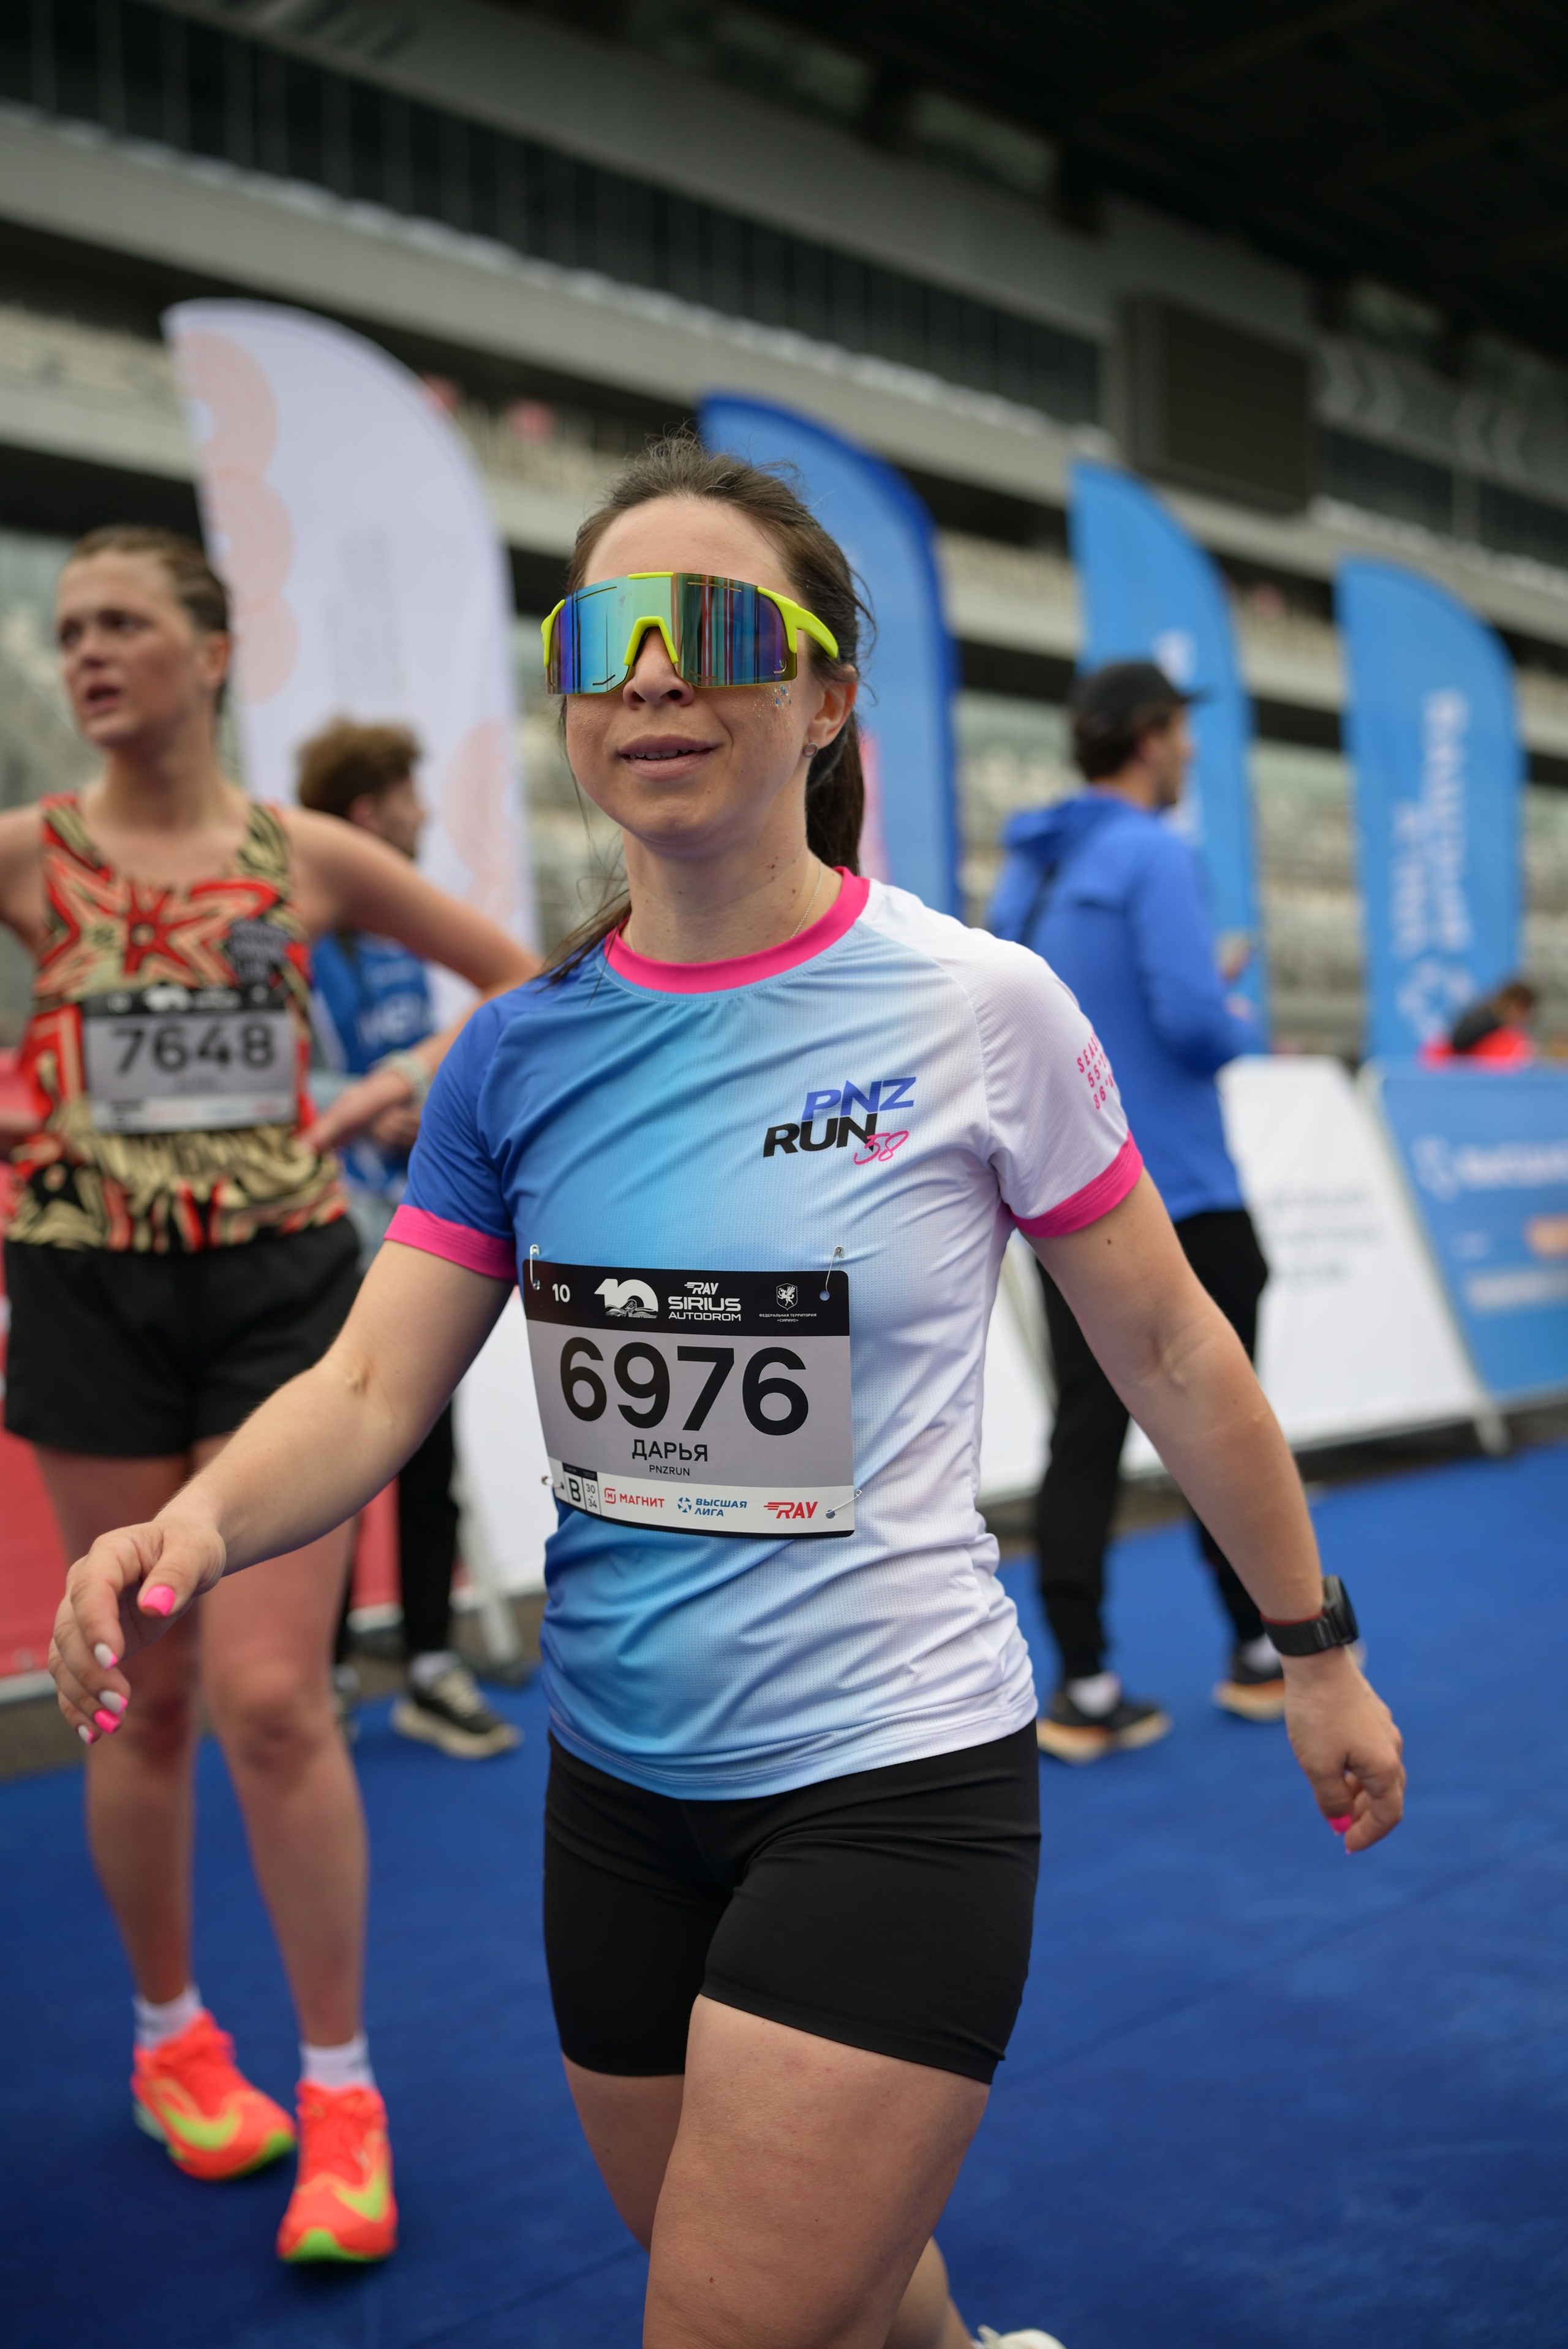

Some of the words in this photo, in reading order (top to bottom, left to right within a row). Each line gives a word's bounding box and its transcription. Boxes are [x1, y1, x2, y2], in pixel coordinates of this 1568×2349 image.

[112, 1024, 275, 1075] 7648
[1077, 1032, 1099, 1073] SEAS
[802, 1076, 916, 1121] PNZ
[763, 1113, 878, 1157] RUN
[854, 1130, 910, 1165] 58
[552, 1284, 570, 1303] 10
[684, 1281, 719, 1295] RAY
[668, 1296, 742, 1312] SIRIUS
[668, 1311, 742, 1322] AUTODROM
[560, 1336, 809, 1436] 6976
[631, 1439, 708, 1462] ДАРЬЯ
[649, 1464, 691, 1477] PNZRUN
[586, 1483, 595, 1494] 30
[588, 1498, 598, 1508] 34
[619, 1492, 665, 1508] МАГНИТ
[695, 1498, 747, 1509] ВЫСШАЯ
[695, 1508, 724, 1517] ЛИГА
[763, 1502, 818, 1519] RAY
